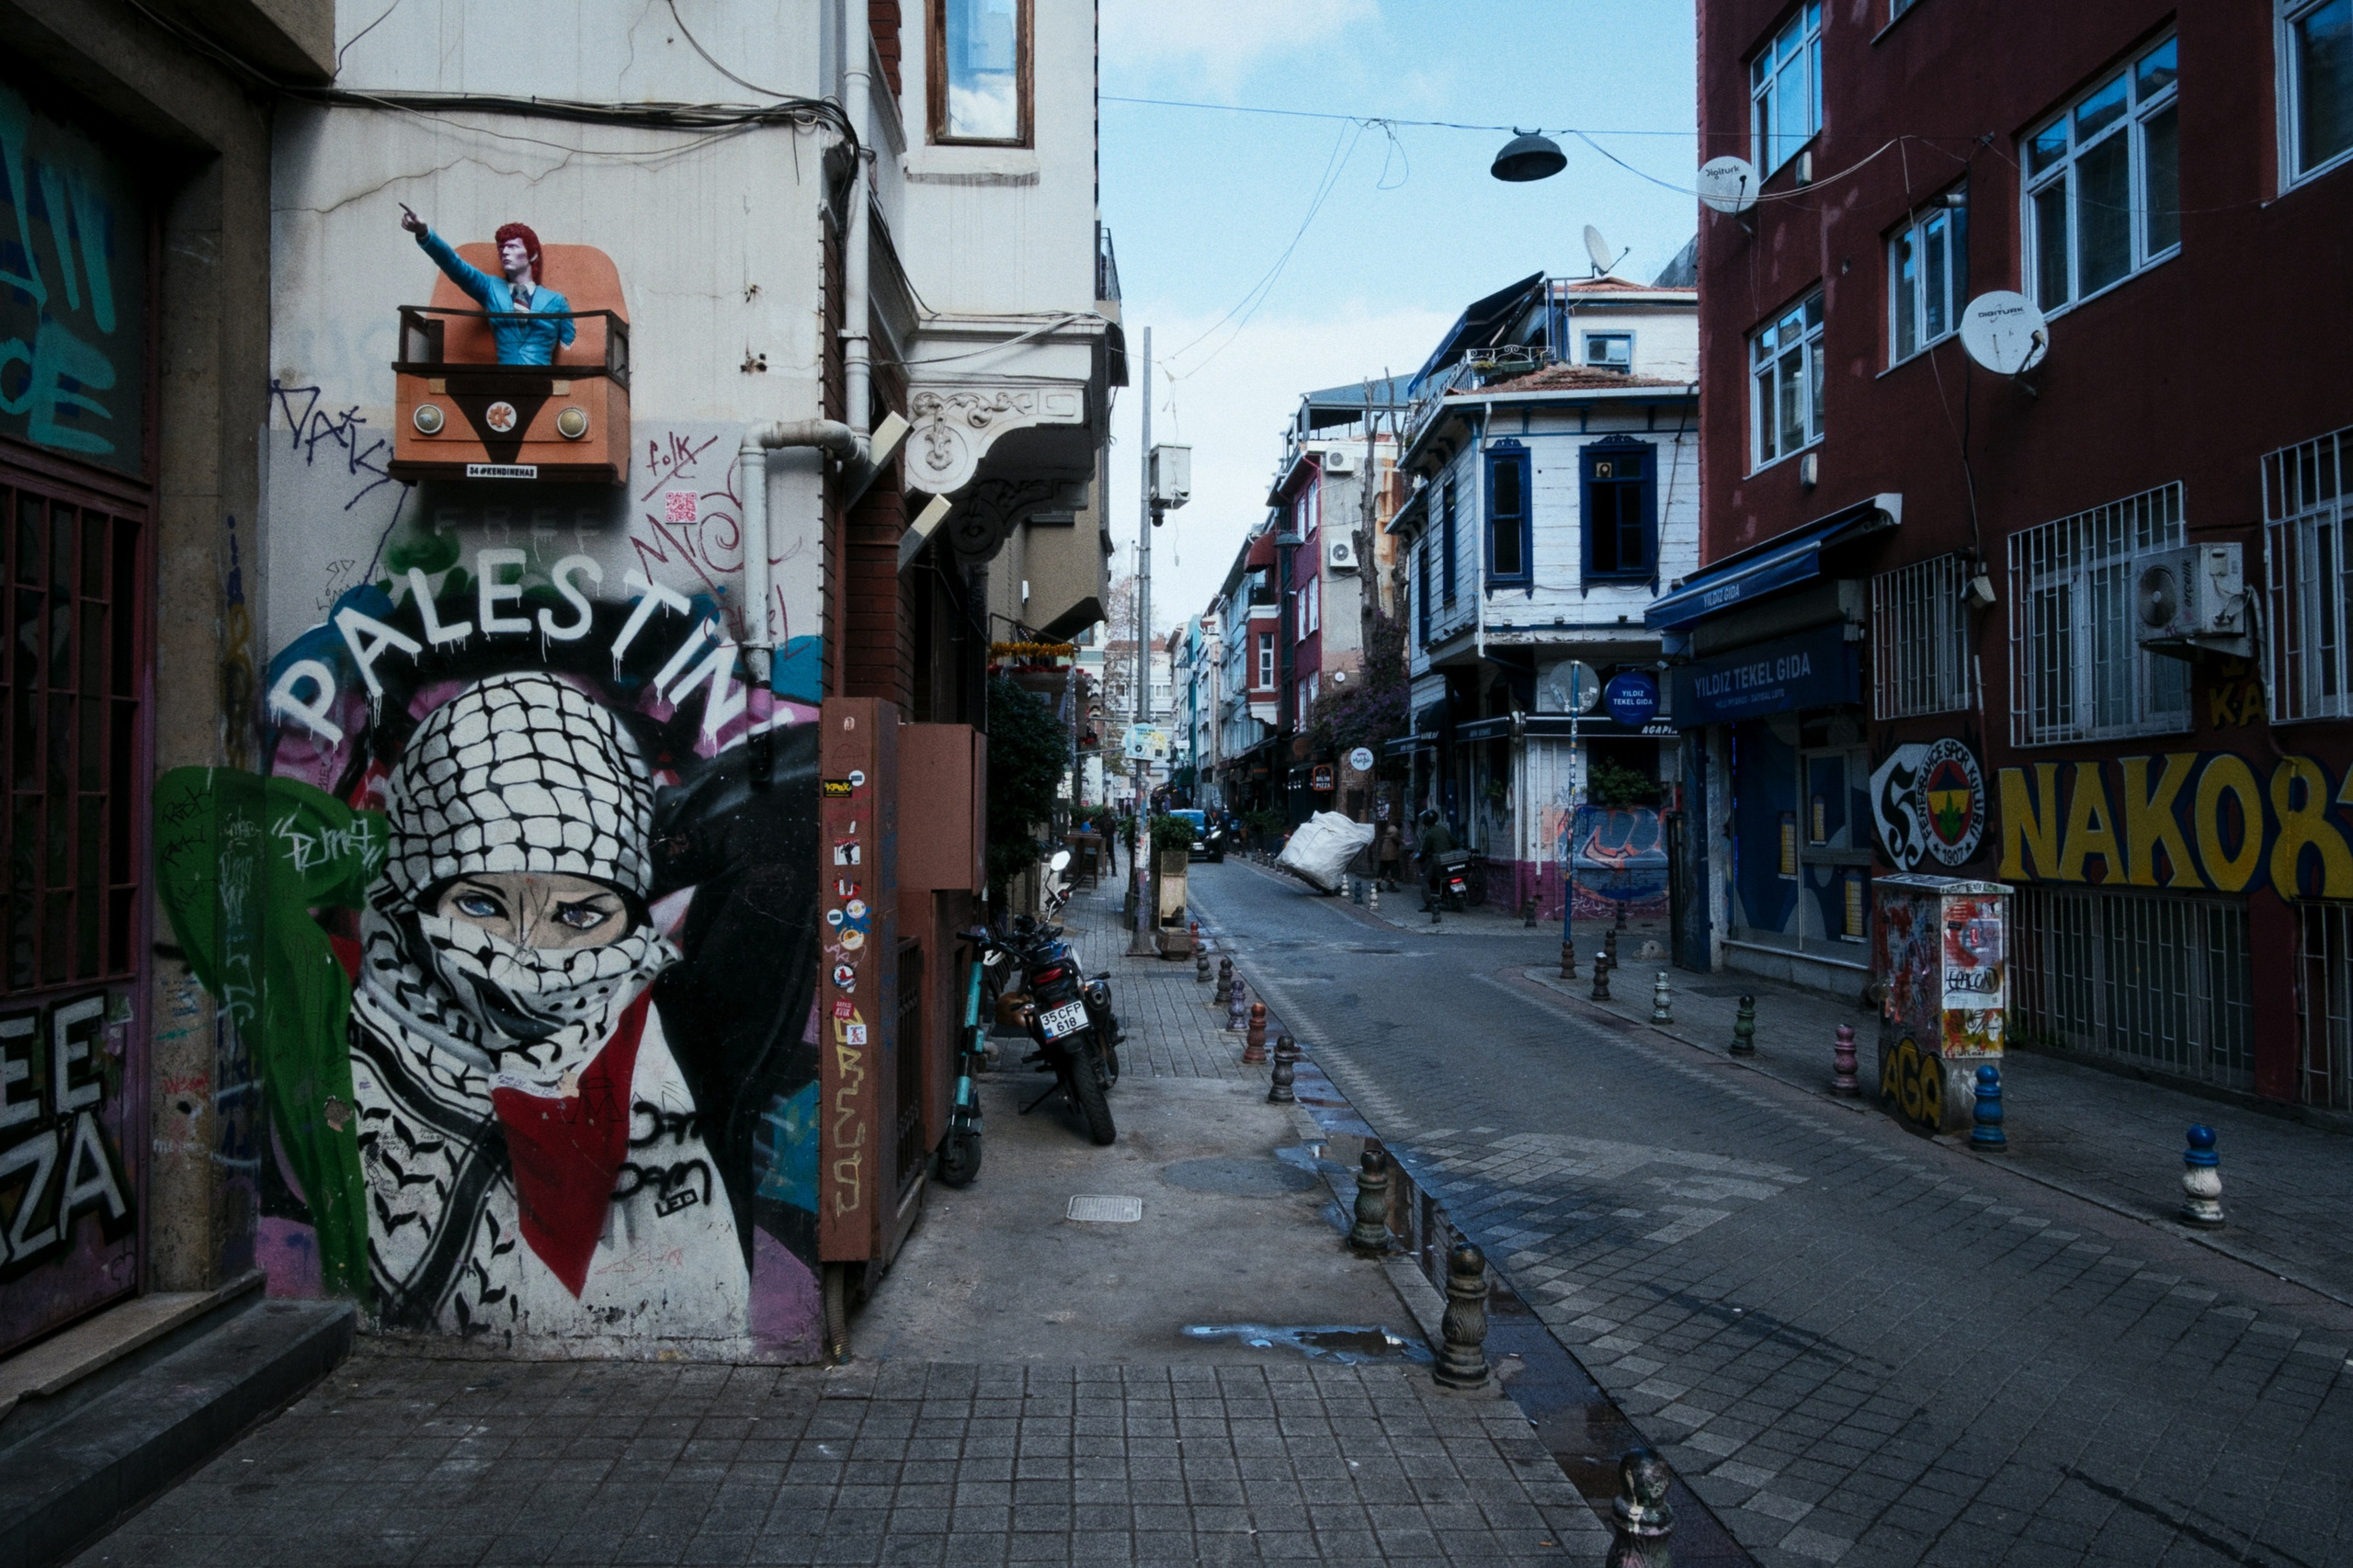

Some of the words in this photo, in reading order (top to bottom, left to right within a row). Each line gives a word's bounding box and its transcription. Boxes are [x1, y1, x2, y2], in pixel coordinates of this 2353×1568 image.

[1978, 306, 2024, 318] DIGITURK
[469, 466, 479, 475] 34
[2182, 559, 2193, 608] arçelik
[1703, 589, 1723, 608] YILDIZ
[1724, 584, 1740, 600] GIDA
[1695, 670, 1732, 699] YILDIZ
[1733, 661, 1774, 690] TEKEL
[1776, 652, 1812, 682] GIDA
[1612, 698, 1635, 706] TEKEL
[1636, 698, 1654, 706] GIDA
[1621, 689, 1644, 698] YILDIZ
[1944, 741, 1970, 770] SPOR
[1998, 752, 2353, 901] NAKO8
[1942, 846, 1963, 864] 1907
[1041, 1011, 1058, 1026] 35
[1058, 1002, 1082, 1019] CFP
[1057, 1017, 1077, 1032] 618
[0, 1110, 127, 1261] ZA
